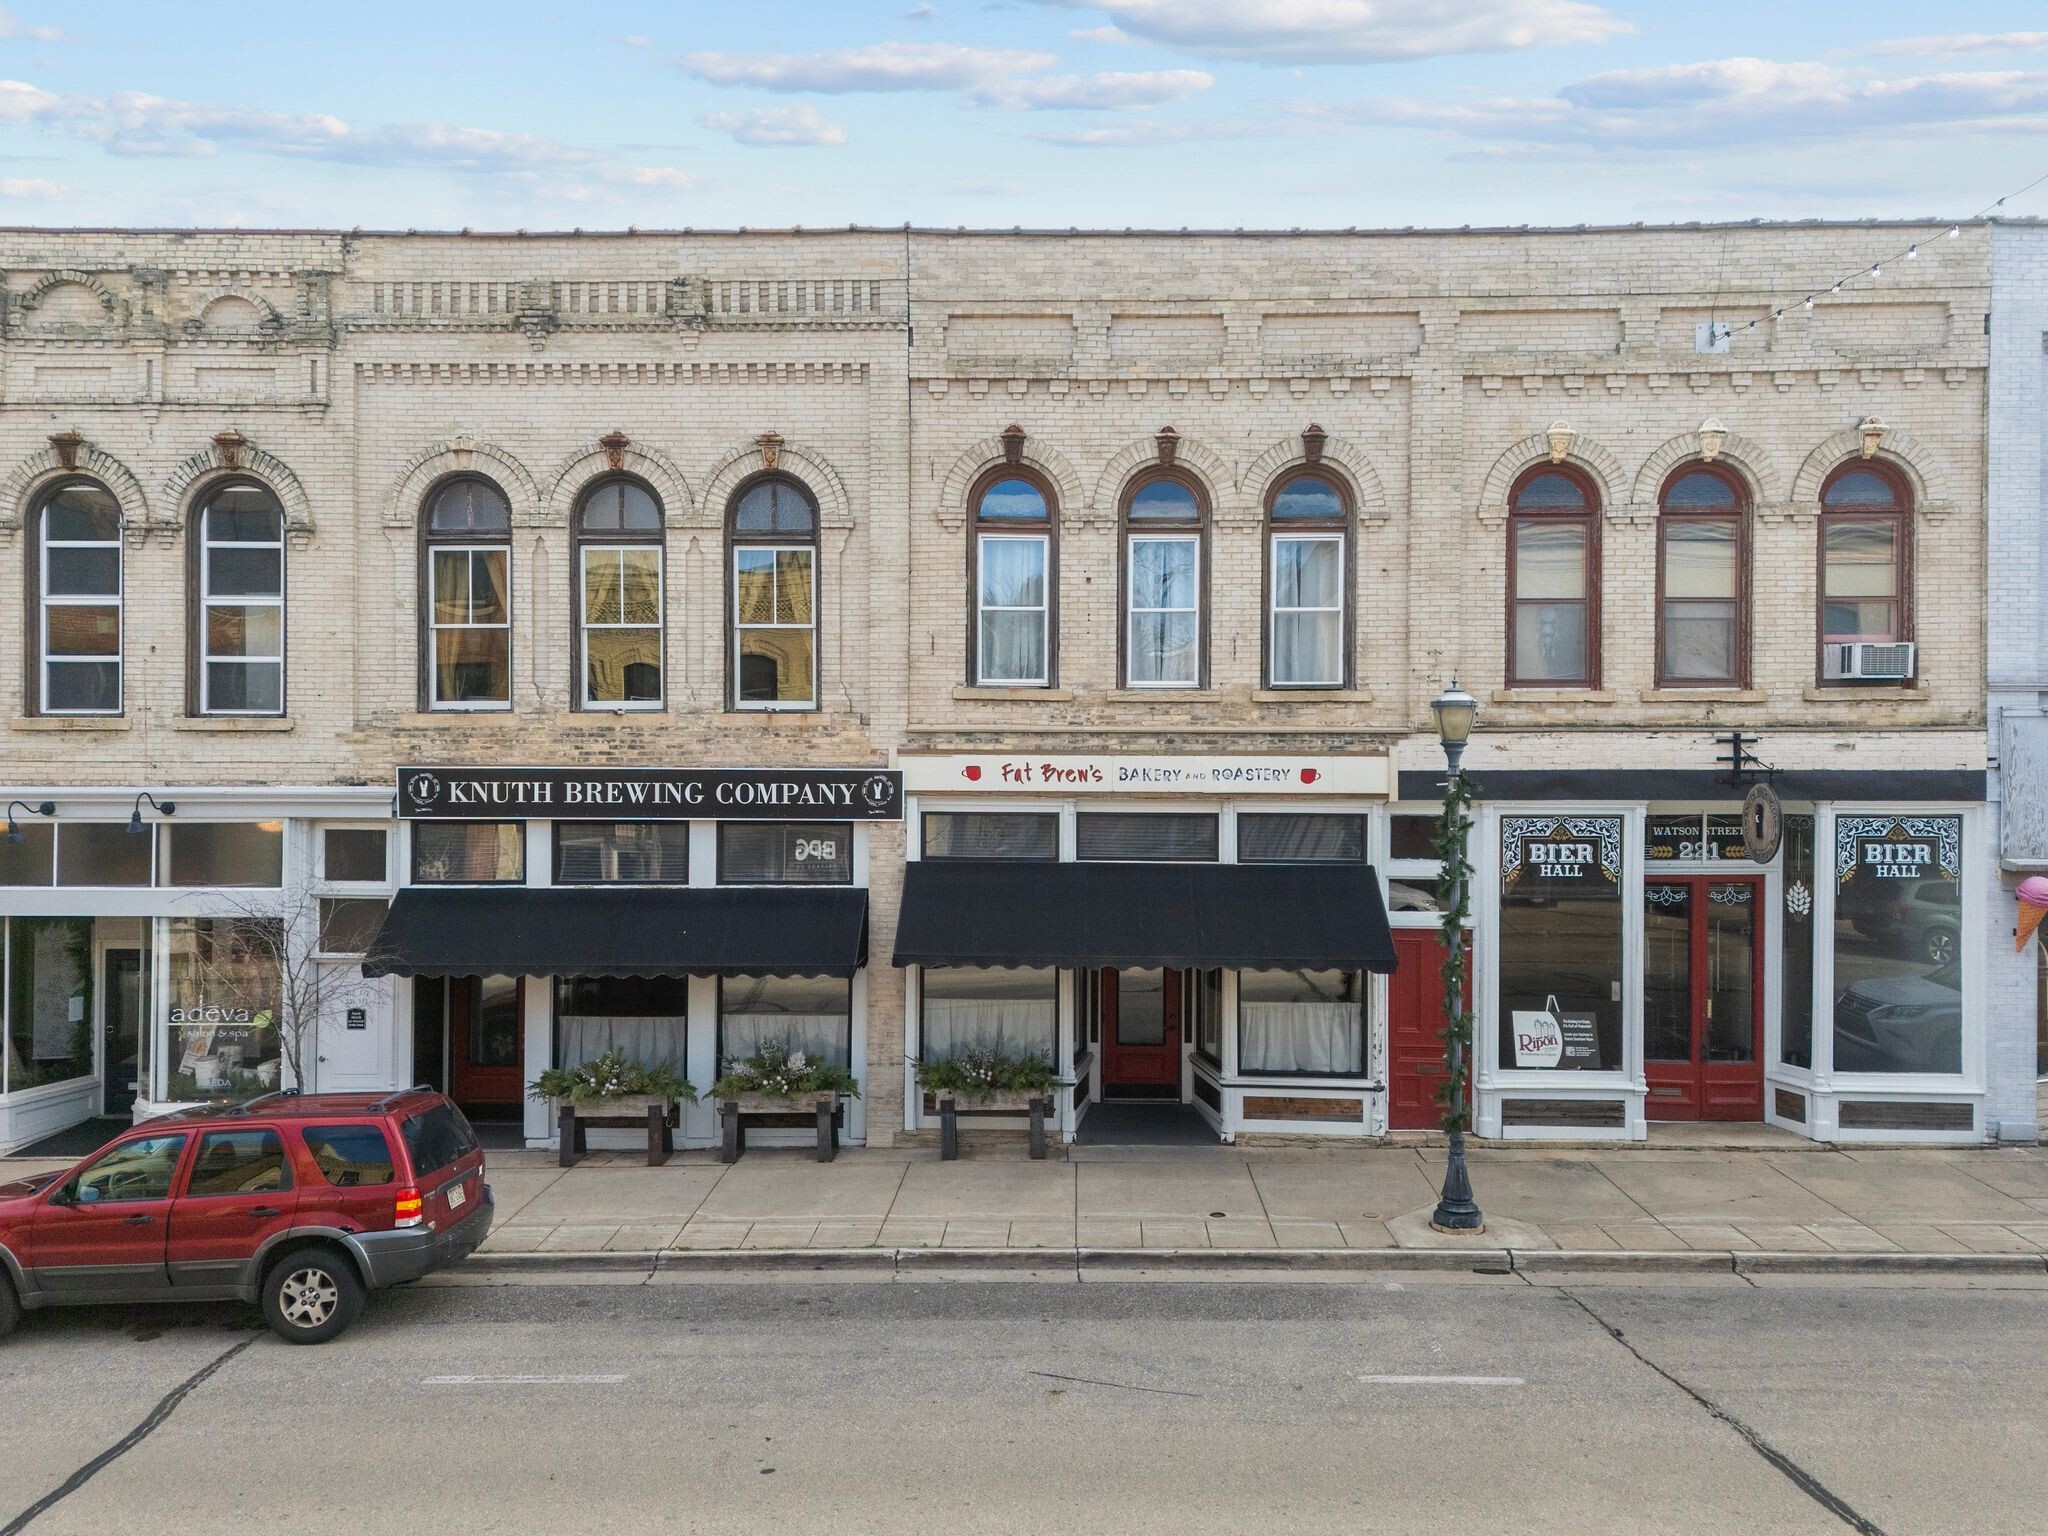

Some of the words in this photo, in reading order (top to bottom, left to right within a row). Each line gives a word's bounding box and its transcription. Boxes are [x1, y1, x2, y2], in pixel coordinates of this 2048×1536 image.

[1001, 762, 1032, 784] Fat
[1119, 767, 1182, 782] BAKERY
[1212, 767, 1291, 782] ROASTERY
[448, 781, 553, 804] KNUTH
[563, 781, 705, 804] BREWING
[715, 782, 857, 805] COMPANY
[1652, 826, 1700, 836] WATSON
[1529, 843, 1594, 864] BIER
[1679, 841, 1720, 860] 221
[1865, 843, 1932, 864] BIER
[1540, 864, 1583, 877] HALL
[1876, 865, 1921, 878] HALL
[187, 1026, 215, 1038] salon
[218, 1029, 226, 1038] &
[229, 1030, 249, 1041] spa
[1518, 1034, 1559, 1052] Ripon
